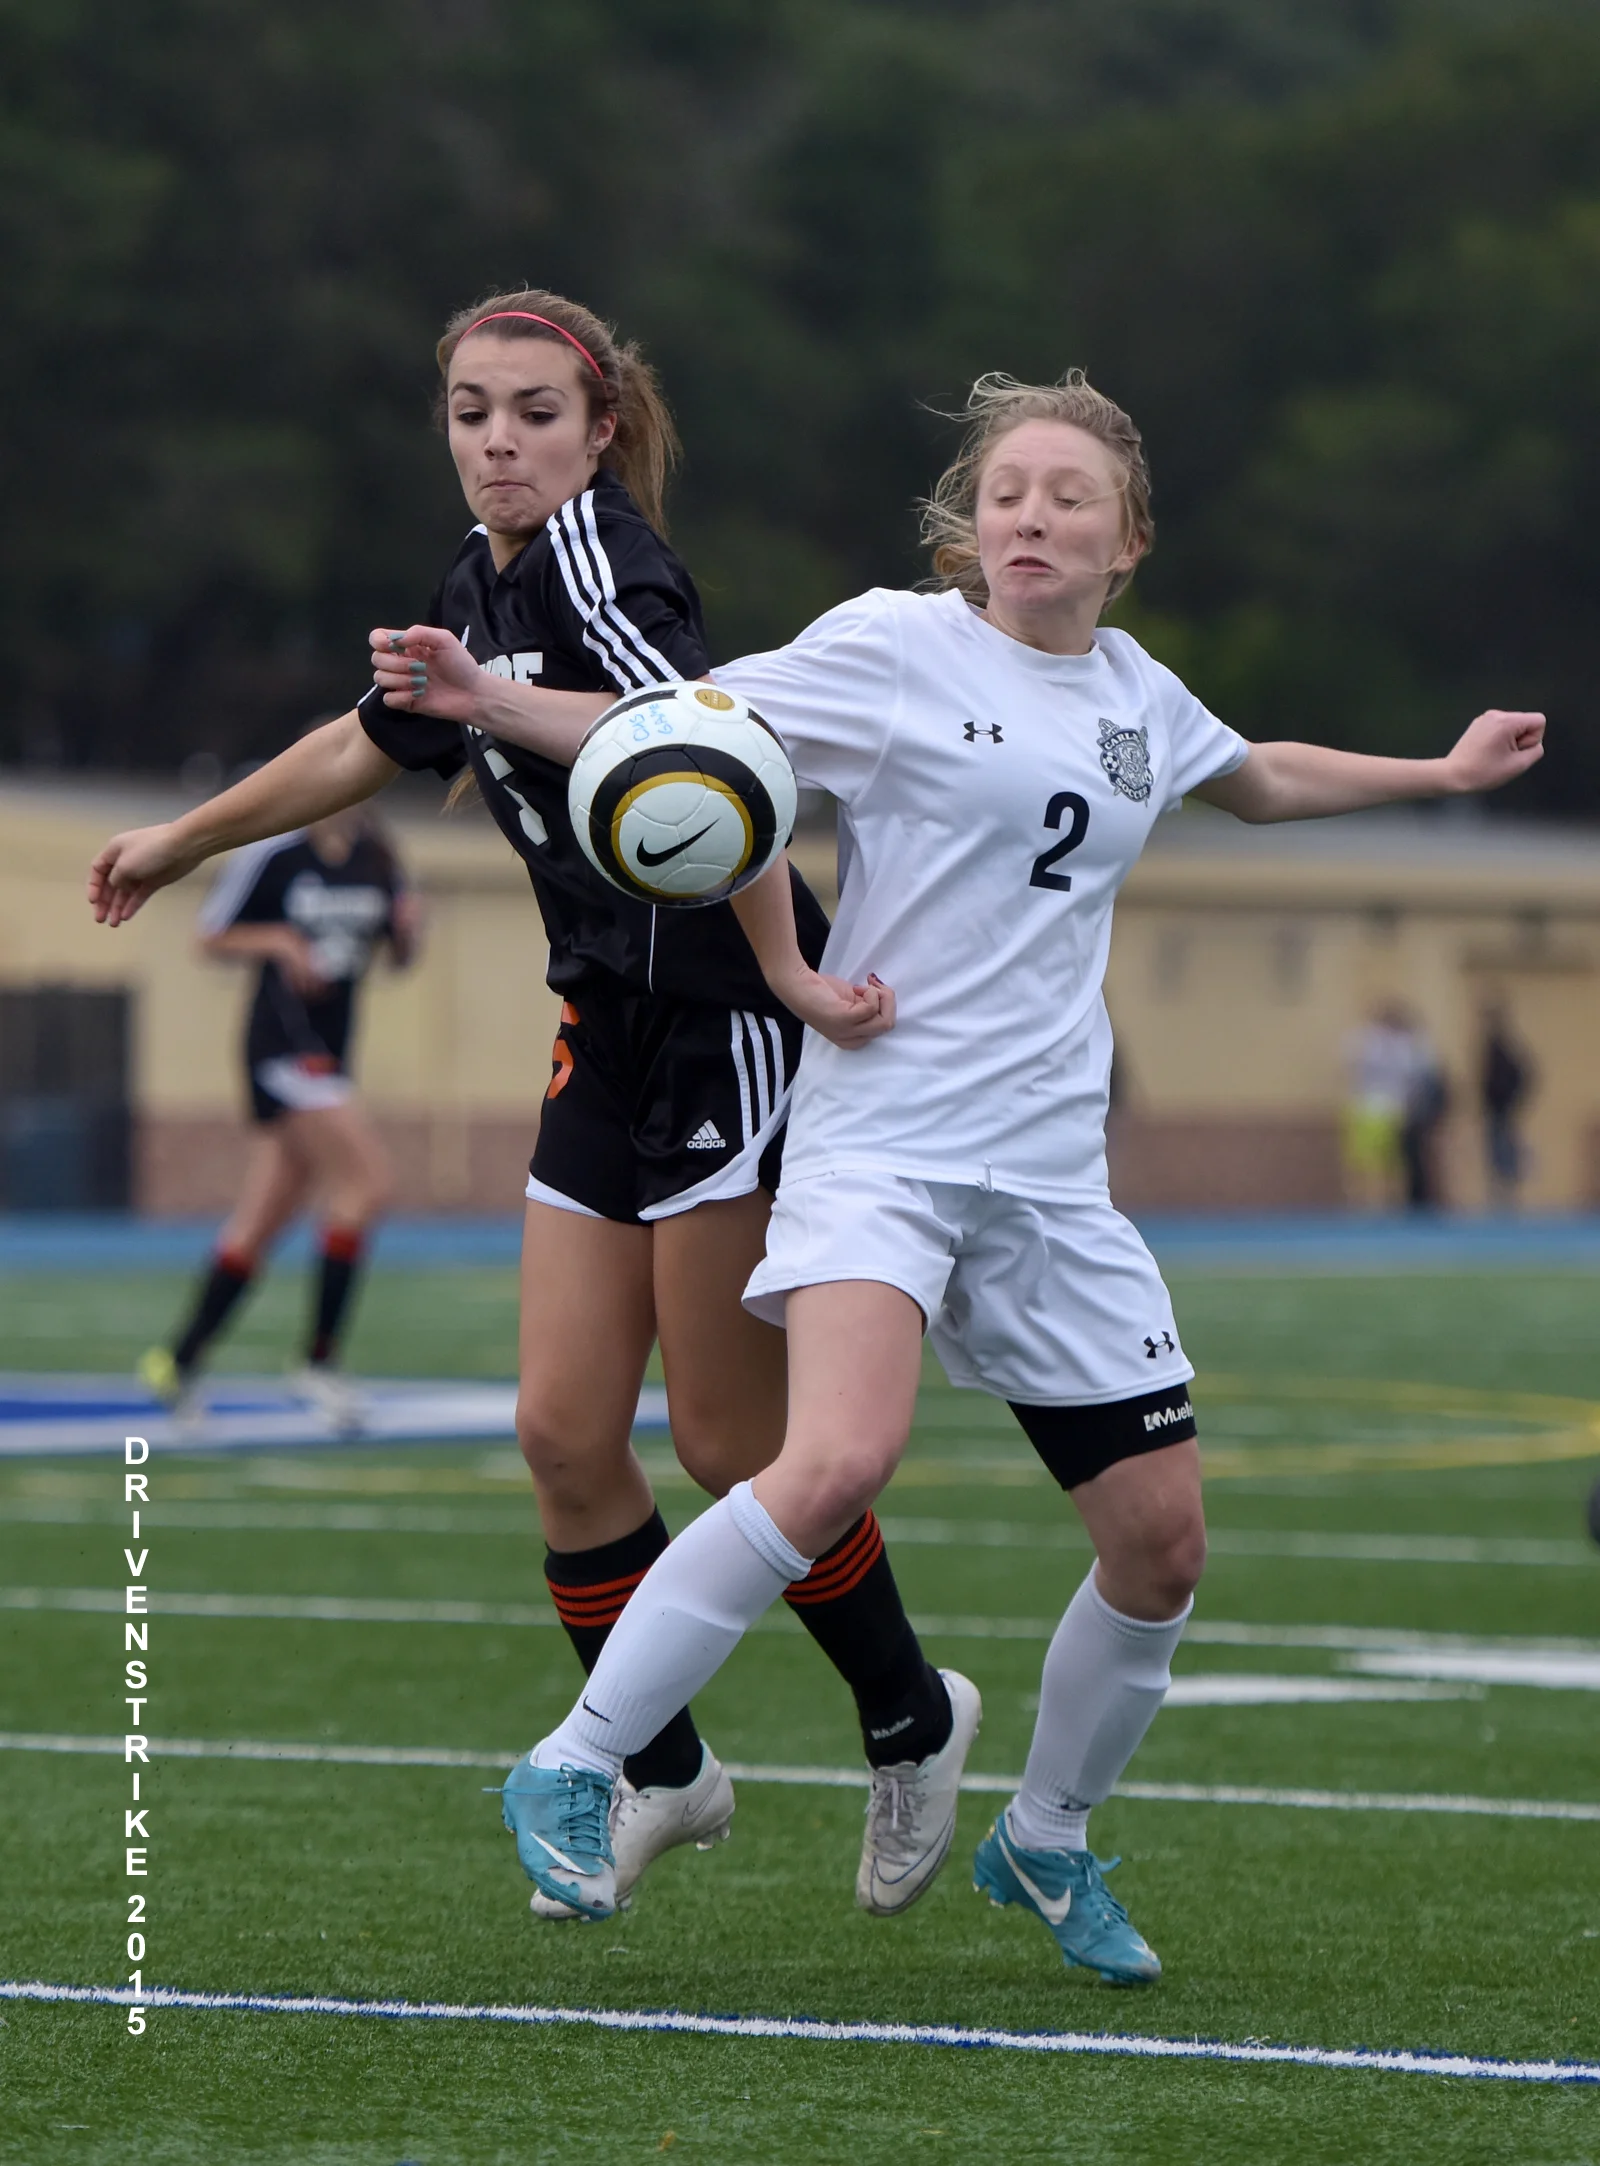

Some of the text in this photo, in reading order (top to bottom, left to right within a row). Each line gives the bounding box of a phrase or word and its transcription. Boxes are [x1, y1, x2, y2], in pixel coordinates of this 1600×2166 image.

[1116, 777, 1148, 799] SOCCER
[1029, 791, 1090, 892] 2
[687, 1138, 727, 1149] adidas
